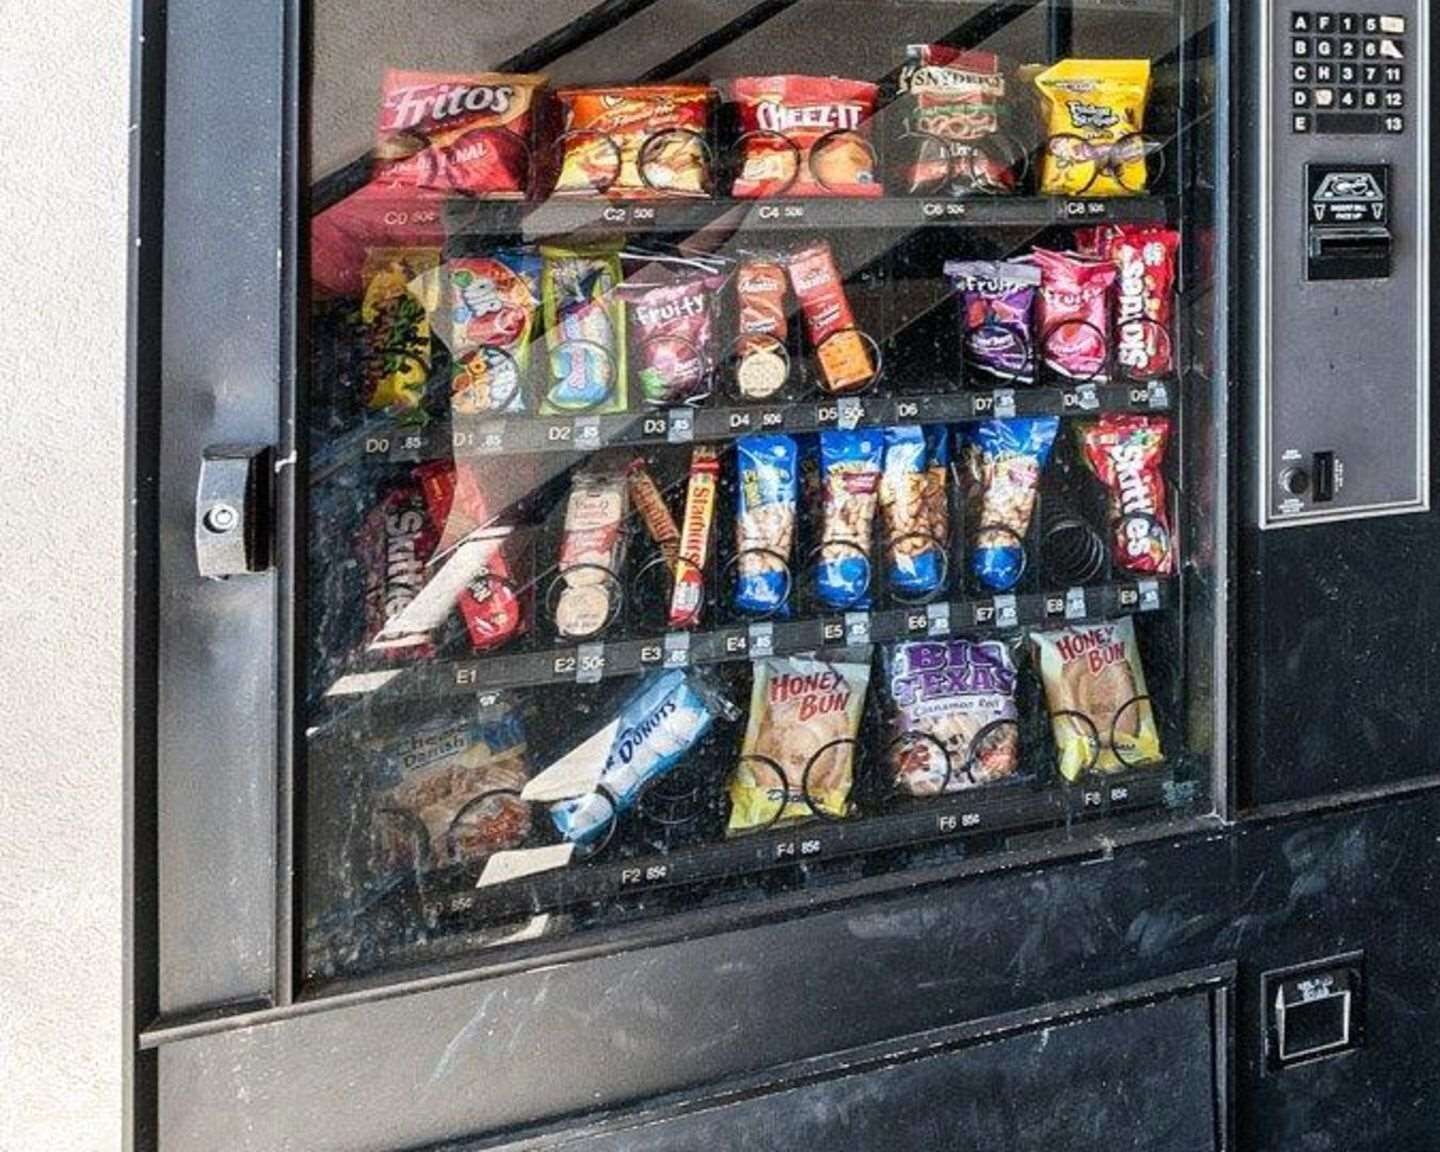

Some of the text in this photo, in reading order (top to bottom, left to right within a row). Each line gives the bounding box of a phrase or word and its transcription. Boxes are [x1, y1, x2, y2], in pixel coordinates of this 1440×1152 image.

[1295, 16, 1376, 31] A F 1 5
[1295, 42, 1376, 55] B G 2 6
[1294, 66, 1401, 80] C H 3 7 11
[1295, 91, 1307, 105] D
[1342, 92, 1353, 105] 4
[1386, 93, 1402, 106] 12
[392, 85, 515, 129] Fritos
[1295, 118, 1402, 131] E 13
[602, 206, 627, 221] C2
[759, 206, 780, 218] C4
[636, 293, 705, 326] Fruity
[899, 404, 918, 417] D6
[976, 398, 993, 410] D7
[818, 407, 838, 420] D5
[644, 420, 665, 433] D3
[730, 414, 750, 427] D4
[548, 426, 570, 440] D2
[1120, 591, 1137, 604] E9
[1047, 600, 1064, 612] E8
[976, 608, 994, 621] E7
[908, 616, 927, 629] E6
[824, 625, 843, 638] E5
[727, 638, 747, 651] E4
[1055, 624, 1117, 661] HONEY
[641, 648, 662, 661] E3
[1087, 641, 1127, 674] BUN
[554, 658, 575, 672] E2
[456, 670, 476, 683] E1
[769, 670, 846, 703] HONEY
[798, 692, 851, 723] BUN
[939, 817, 956, 830] F6
[621, 869, 642, 883] F2
